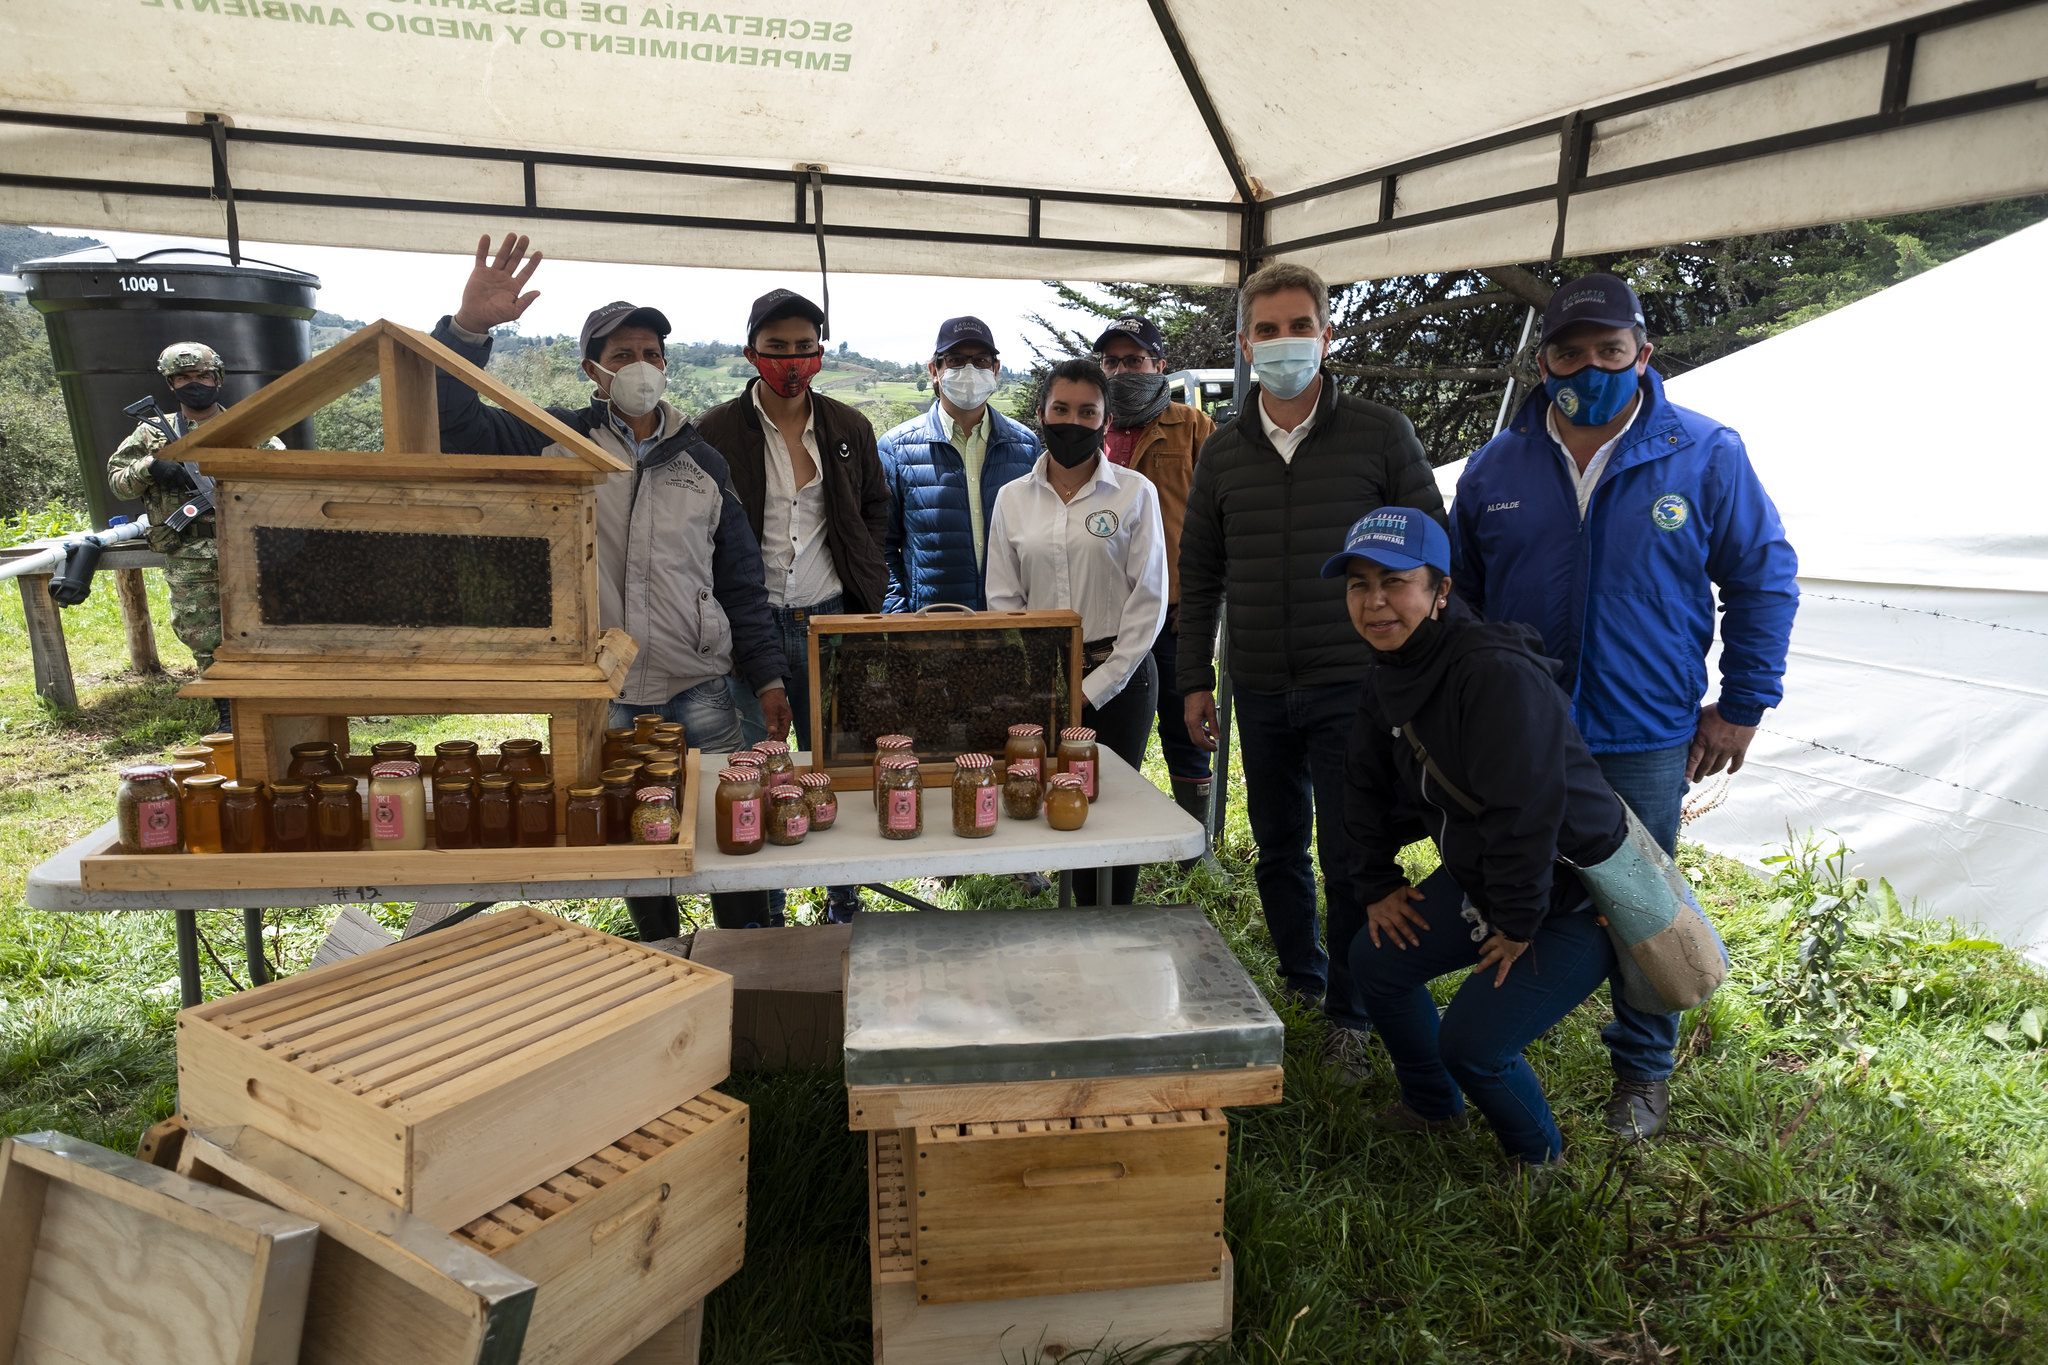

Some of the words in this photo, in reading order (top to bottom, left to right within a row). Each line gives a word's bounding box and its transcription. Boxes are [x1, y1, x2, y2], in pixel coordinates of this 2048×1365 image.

[163, 278, 175, 292] L
[1487, 500, 1520, 512] ALCALDE
[1362, 520, 1406, 530] CAMBIO
